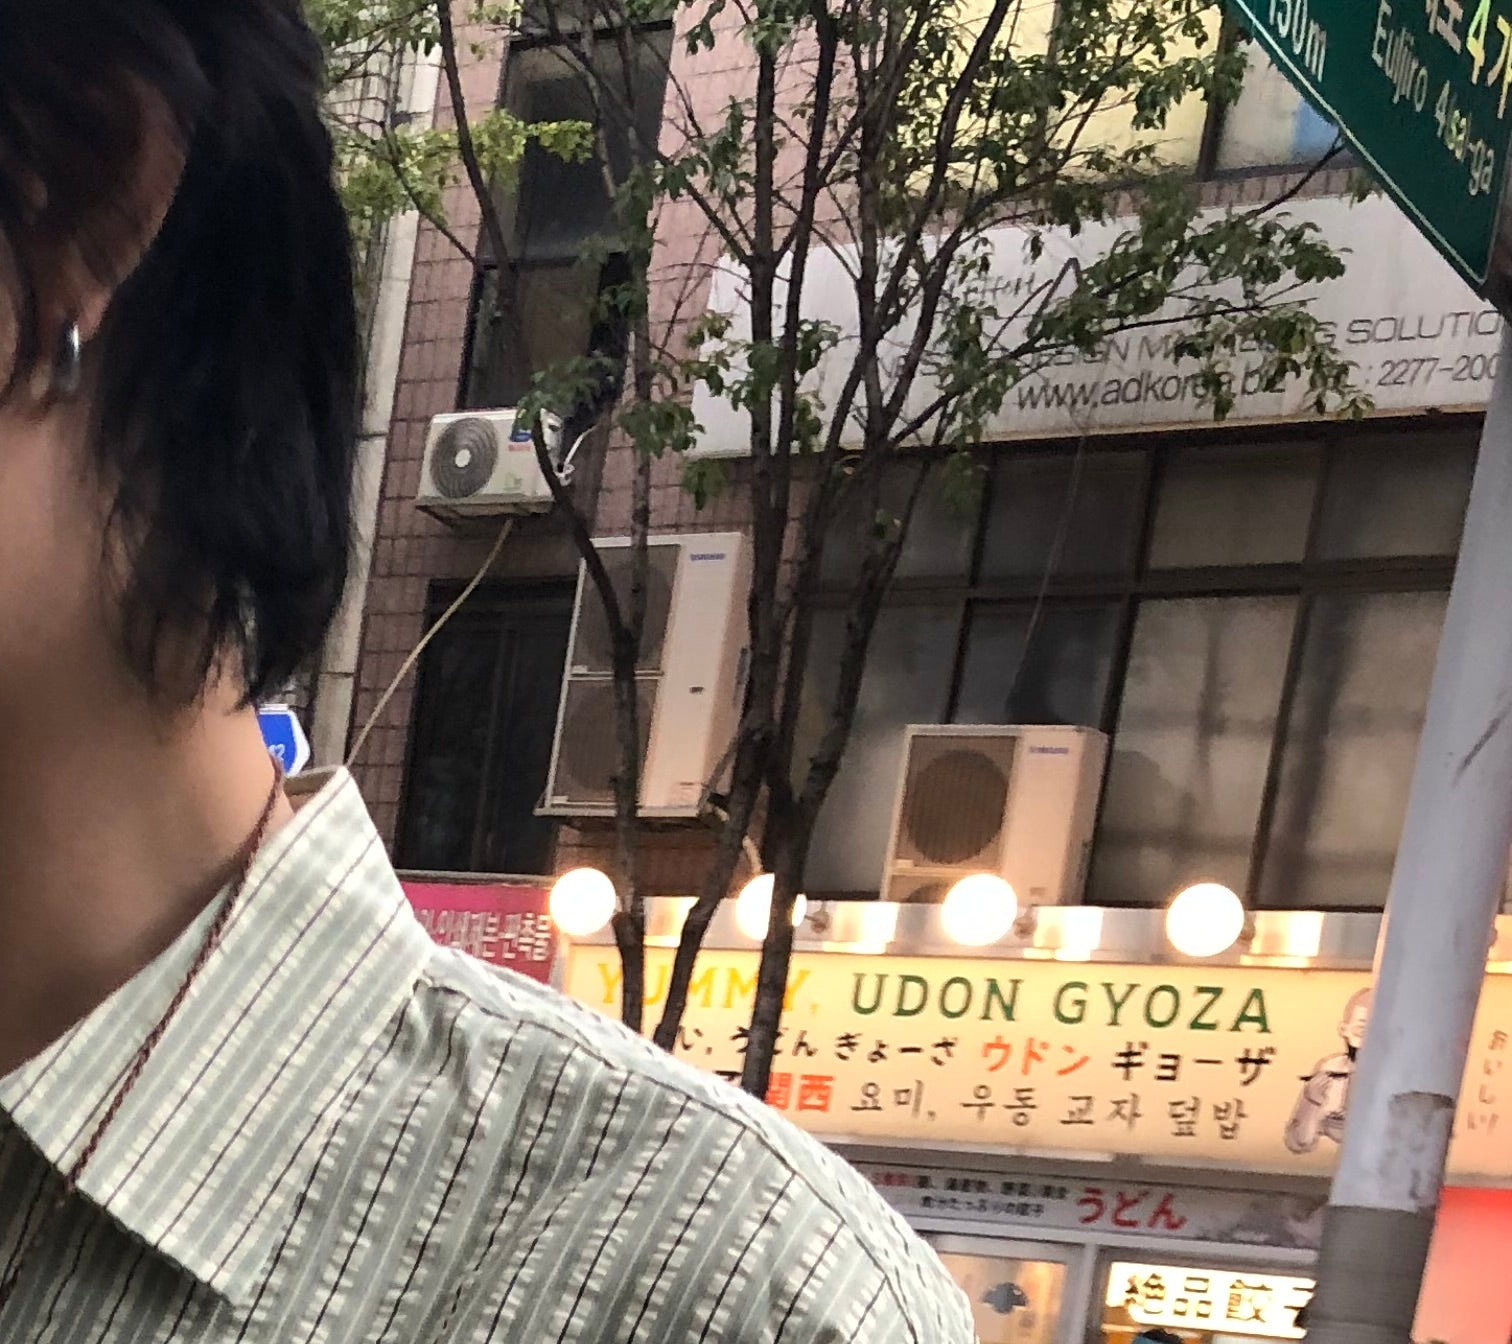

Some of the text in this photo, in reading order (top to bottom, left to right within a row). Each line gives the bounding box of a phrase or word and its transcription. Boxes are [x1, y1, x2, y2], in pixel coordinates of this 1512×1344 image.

[852, 971, 1024, 1021] UDON
[1053, 980, 1273, 1034] GYOZA
[981, 1035, 1091, 1078] ウドン
[1110, 1040, 1277, 1087] ギョーザ
[960, 1084, 1039, 1127] 우동
[1059, 1093, 1143, 1133] 교자
[1167, 1096, 1248, 1140] 덮밥
[1076, 1186, 1187, 1231] うどん
